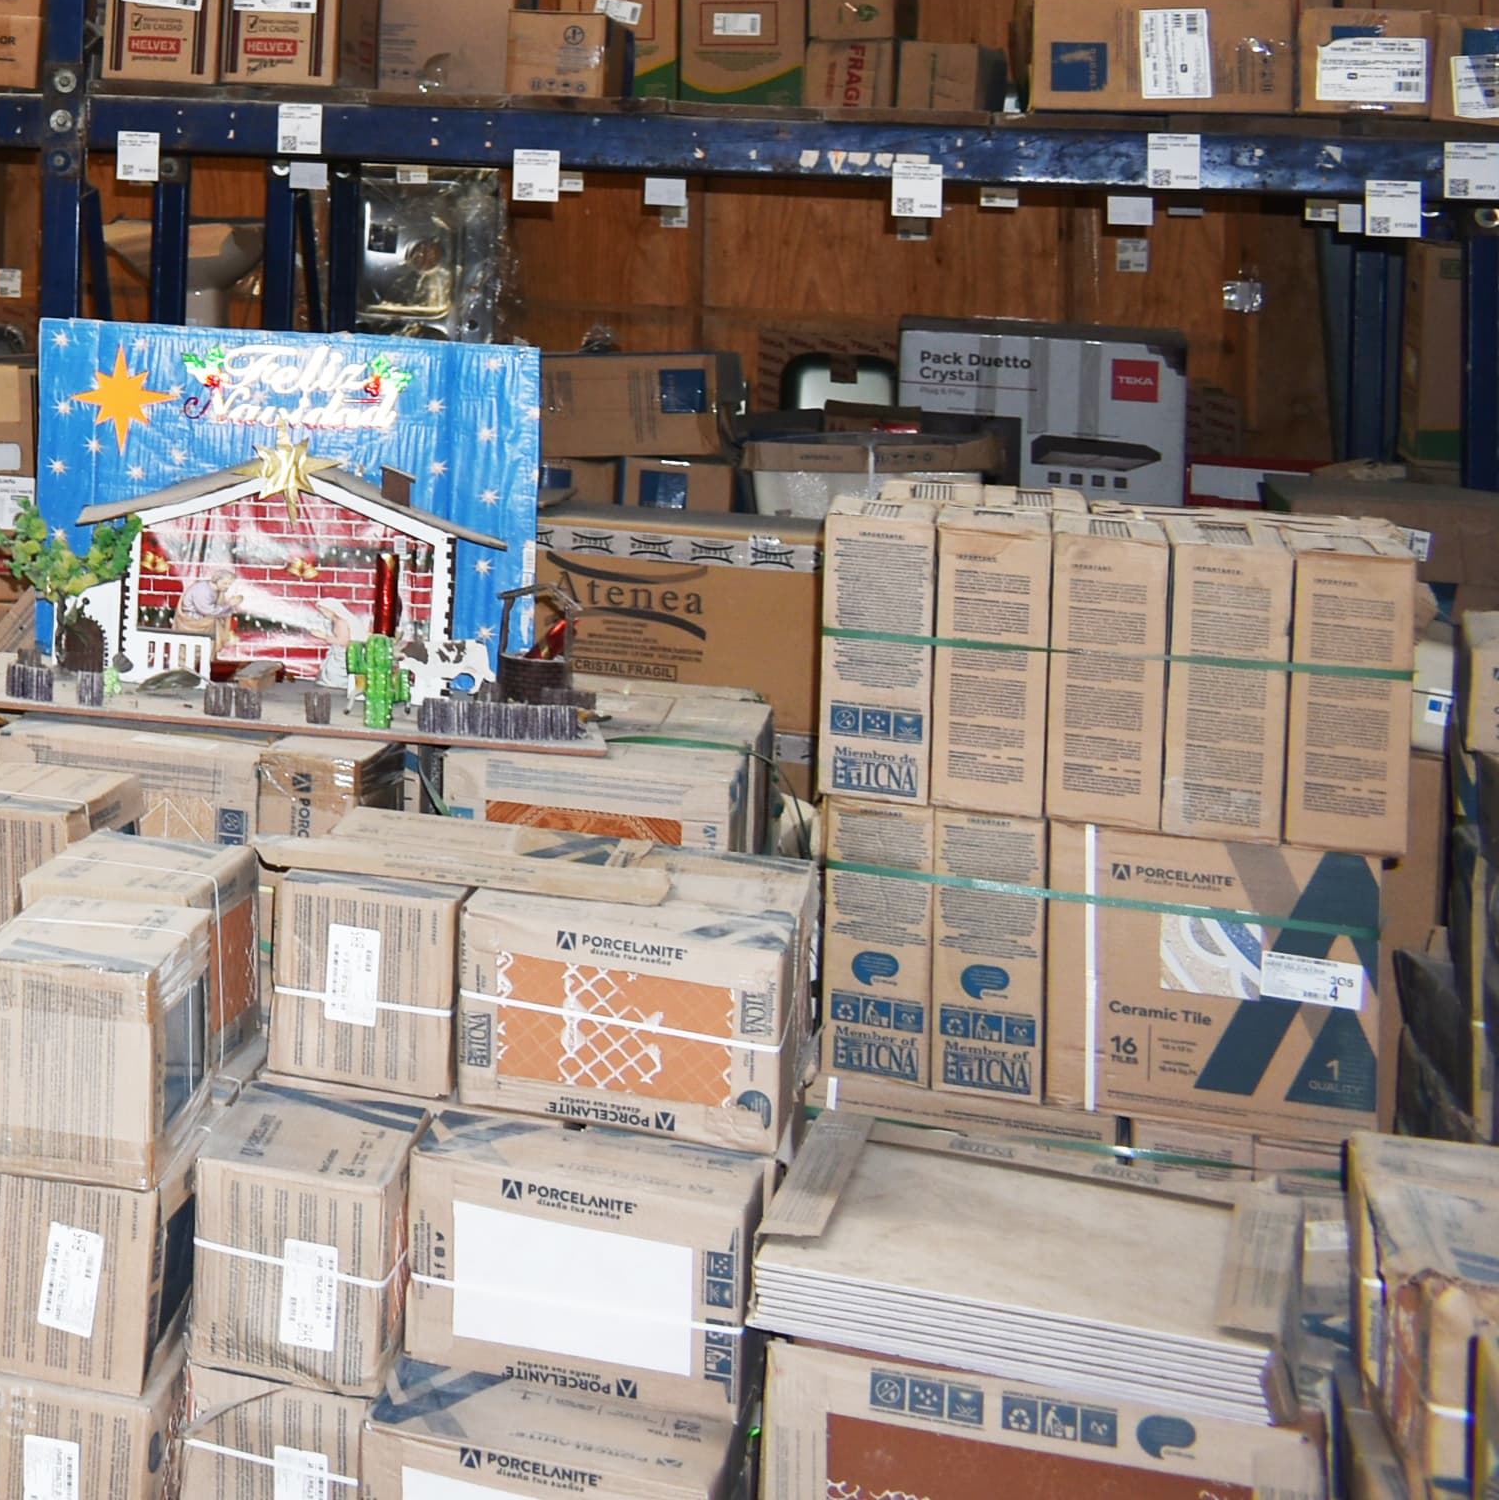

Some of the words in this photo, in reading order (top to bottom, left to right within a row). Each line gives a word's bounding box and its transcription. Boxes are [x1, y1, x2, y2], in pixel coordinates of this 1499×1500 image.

[153, 23, 184, 31] CALIDAD
[269, 25, 299, 33] CALIDAD
[131, 40, 177, 51] HELVEX
[246, 41, 294, 53] HELVEX
[224, 344, 368, 394] Feliz
[919, 350, 963, 367] Pack
[968, 352, 1032, 370] Duetto
[919, 366, 981, 385] Crystal
[1116, 375, 1154, 386] TEKA
[184, 388, 398, 429] Navidad
[557, 571, 703, 615] Atenea
[575, 659, 626, 674] CRISTAL
[628, 664, 672, 678] FRAGIL
[835, 745, 895, 762] Miembro
[899, 754, 916, 763] de
[863, 761, 914, 790] TCNA
[1135, 865, 1233, 887] PORCELANITE
[582, 934, 683, 960] PORCELANITE
[1109, 1000, 1178, 1022] Ceramic
[1180, 1010, 1212, 1026] Tile
[835, 1025, 899, 1044] Member
[902, 1037, 918, 1047] of
[1110, 1035, 1137, 1056] 16
[864, 1043, 917, 1075] TCNA
[945, 1040, 1009, 1059] Member
[1012, 1051, 1029, 1061] of
[1110, 1054, 1139, 1065] TILES
[973, 1057, 1028, 1088] TCNA
[1325, 1060, 1340, 1080] 1
[1308, 1080, 1363, 1093] QUALITY
[548, 1101, 650, 1127] PORCELANITE
[527, 1183, 633, 1215] PORCELANITE
[537, 1200, 568, 1211] diseña
[570, 1206, 586, 1214] tus
[588, 1209, 621, 1220] sueños
[505, 1365, 611, 1395] PORCELANITE
[487, 1452, 599, 1487] PORCELANITE
[496, 1468, 530, 1481] diseña
[532, 1476, 548, 1485] tus
[550, 1480, 585, 1493] sueños
